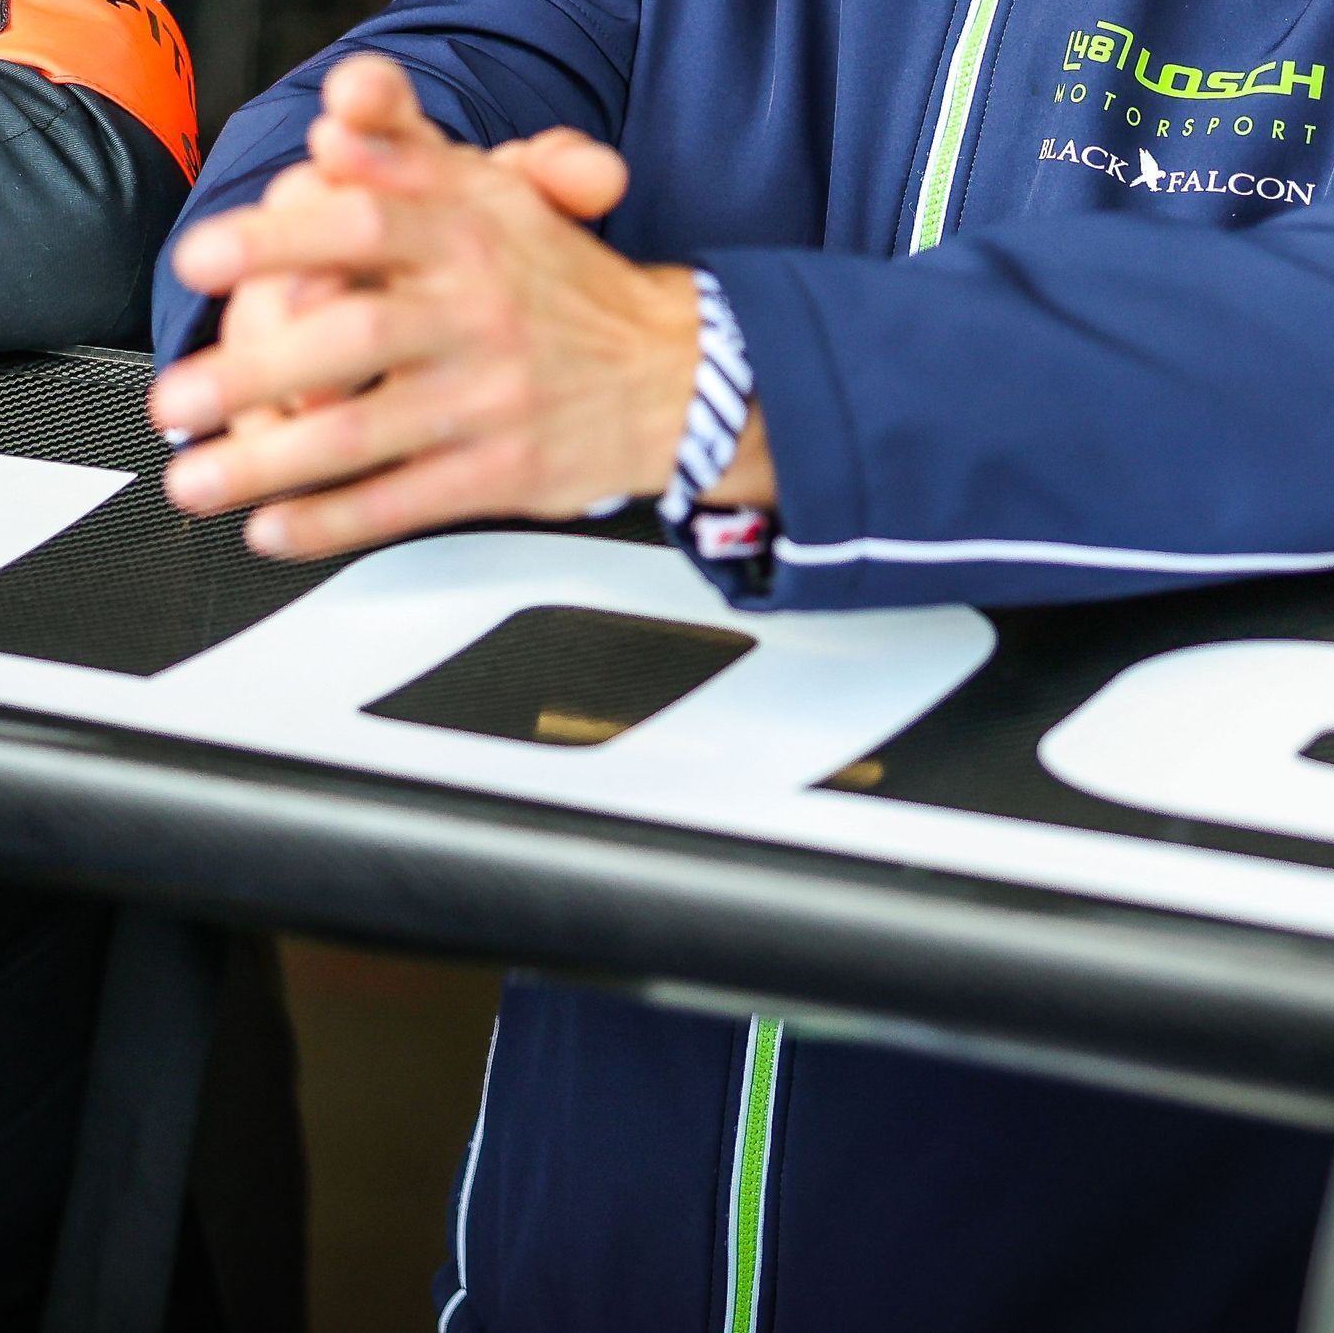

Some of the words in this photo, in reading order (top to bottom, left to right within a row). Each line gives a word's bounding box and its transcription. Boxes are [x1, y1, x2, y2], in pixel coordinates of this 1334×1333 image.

[1134, 46, 1326, 101] LOSCH
[1053, 82, 1318, 145] MOTORSPORT
[1038, 137, 1130, 184] BLACK
[1165, 170, 1317, 207] FALCON
